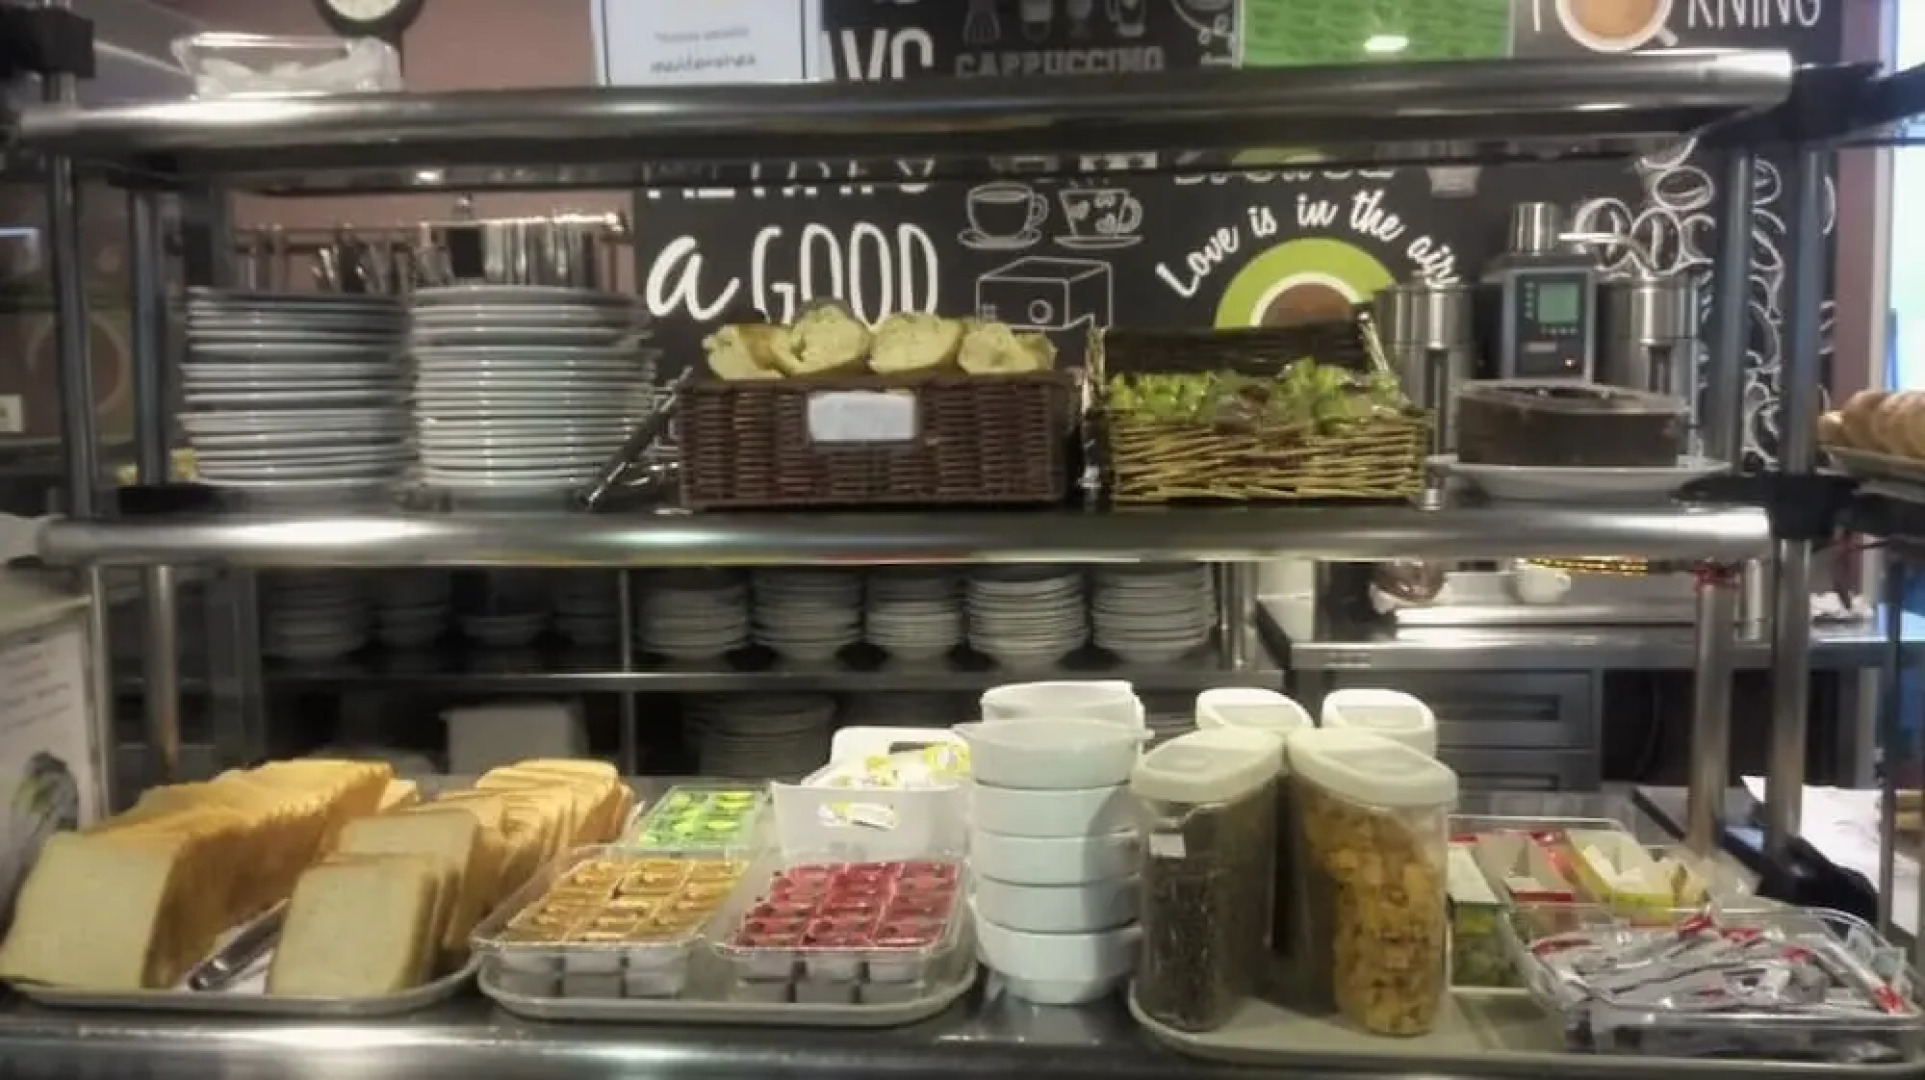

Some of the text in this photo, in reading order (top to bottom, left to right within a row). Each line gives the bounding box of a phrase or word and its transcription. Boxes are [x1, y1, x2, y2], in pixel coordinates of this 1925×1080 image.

[955, 46, 1164, 79] CAPPUCCINO
[646, 222, 938, 333] a GOOD
[1155, 225, 1239, 298] Love
[1247, 206, 1278, 237] is
[1296, 193, 1339, 228] in
[1350, 188, 1406, 242] the
